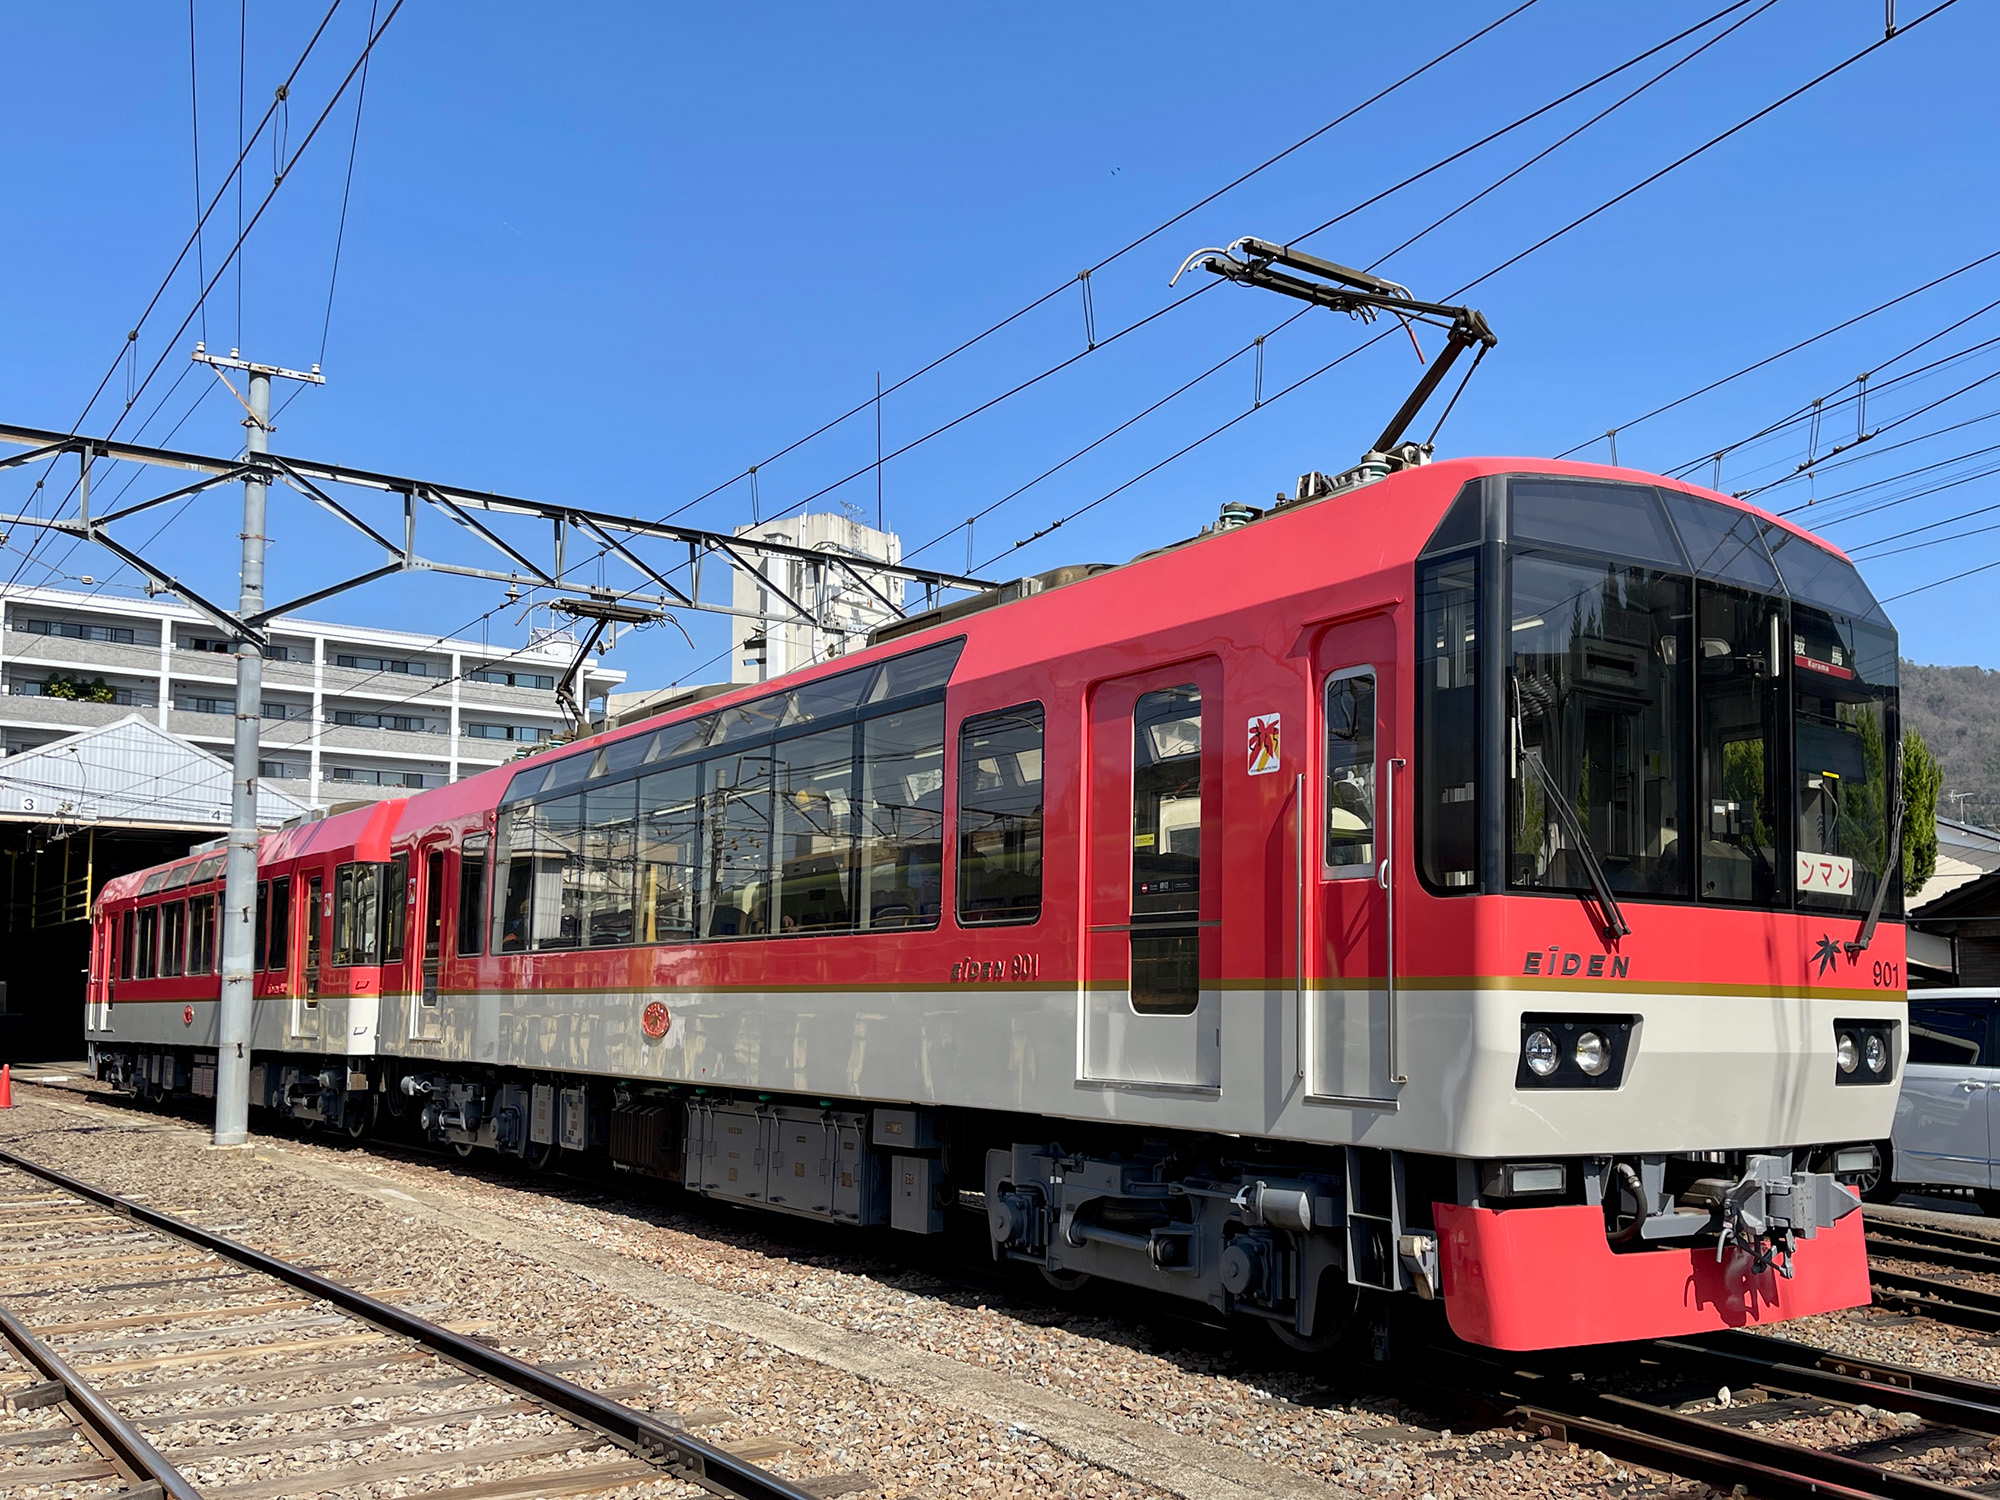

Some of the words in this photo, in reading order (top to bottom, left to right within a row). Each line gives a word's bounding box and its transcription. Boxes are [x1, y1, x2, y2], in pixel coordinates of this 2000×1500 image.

[1808, 660, 1830, 673] Kurama
[23, 798, 34, 811] 3
[211, 810, 221, 821] 4
[1011, 953, 1039, 978] 901
[1872, 960, 1899, 989] 901
